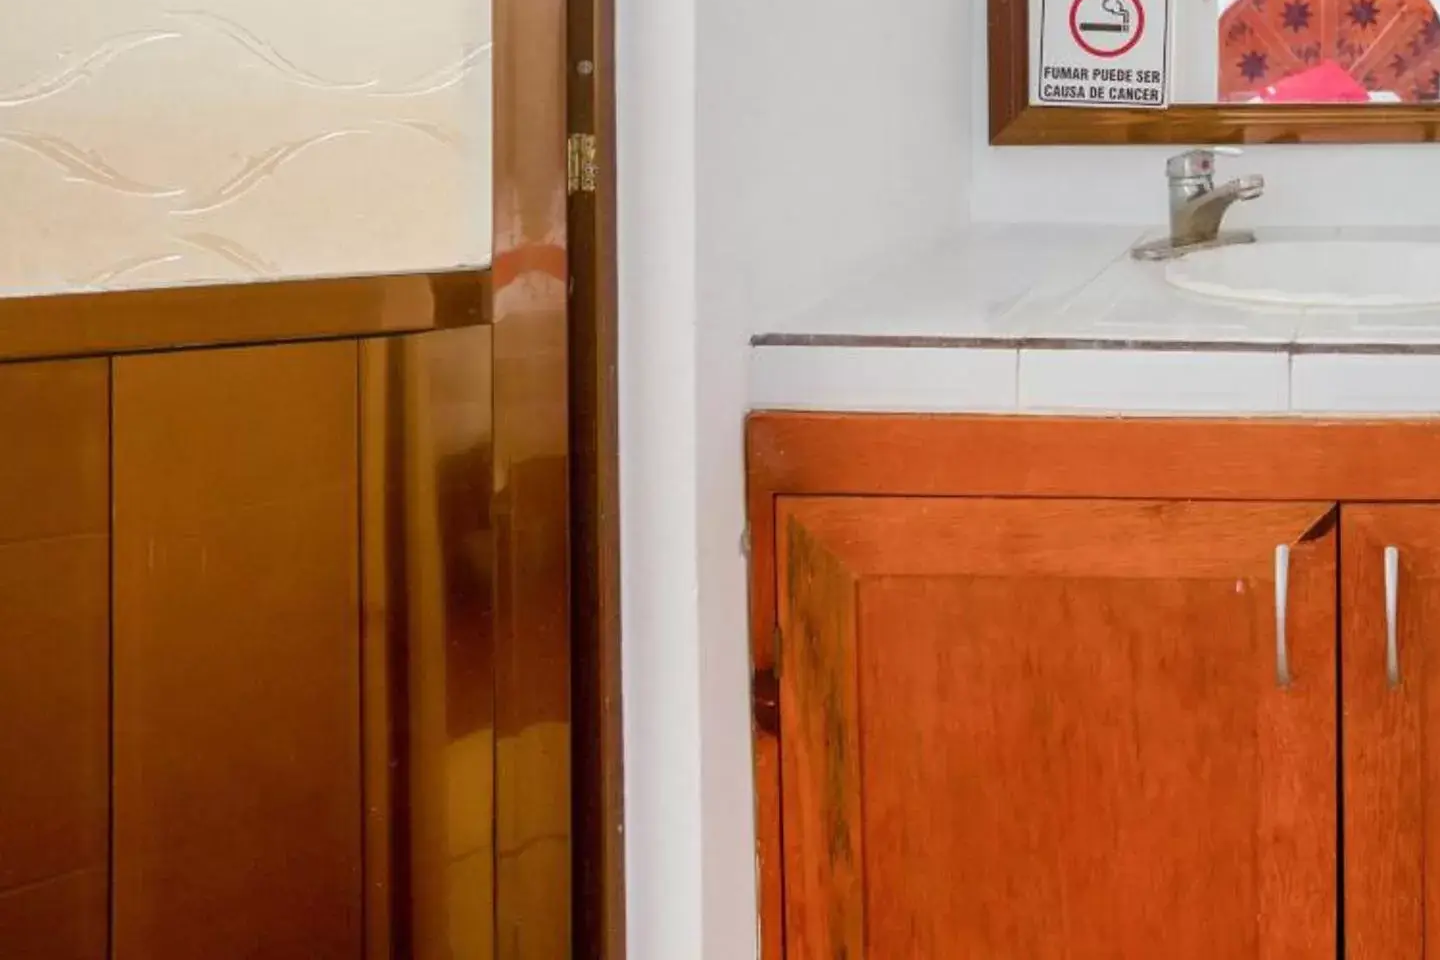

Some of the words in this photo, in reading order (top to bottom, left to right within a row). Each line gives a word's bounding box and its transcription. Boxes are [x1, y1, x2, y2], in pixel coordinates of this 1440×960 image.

[1043, 66, 1089, 80] FUMAR
[1092, 68, 1133, 81] PUEDE
[1136, 70, 1161, 83] SER
[1043, 84, 1085, 98] CAUSA
[1089, 86, 1104, 99] DE
[1108, 87, 1158, 101] CANCER
